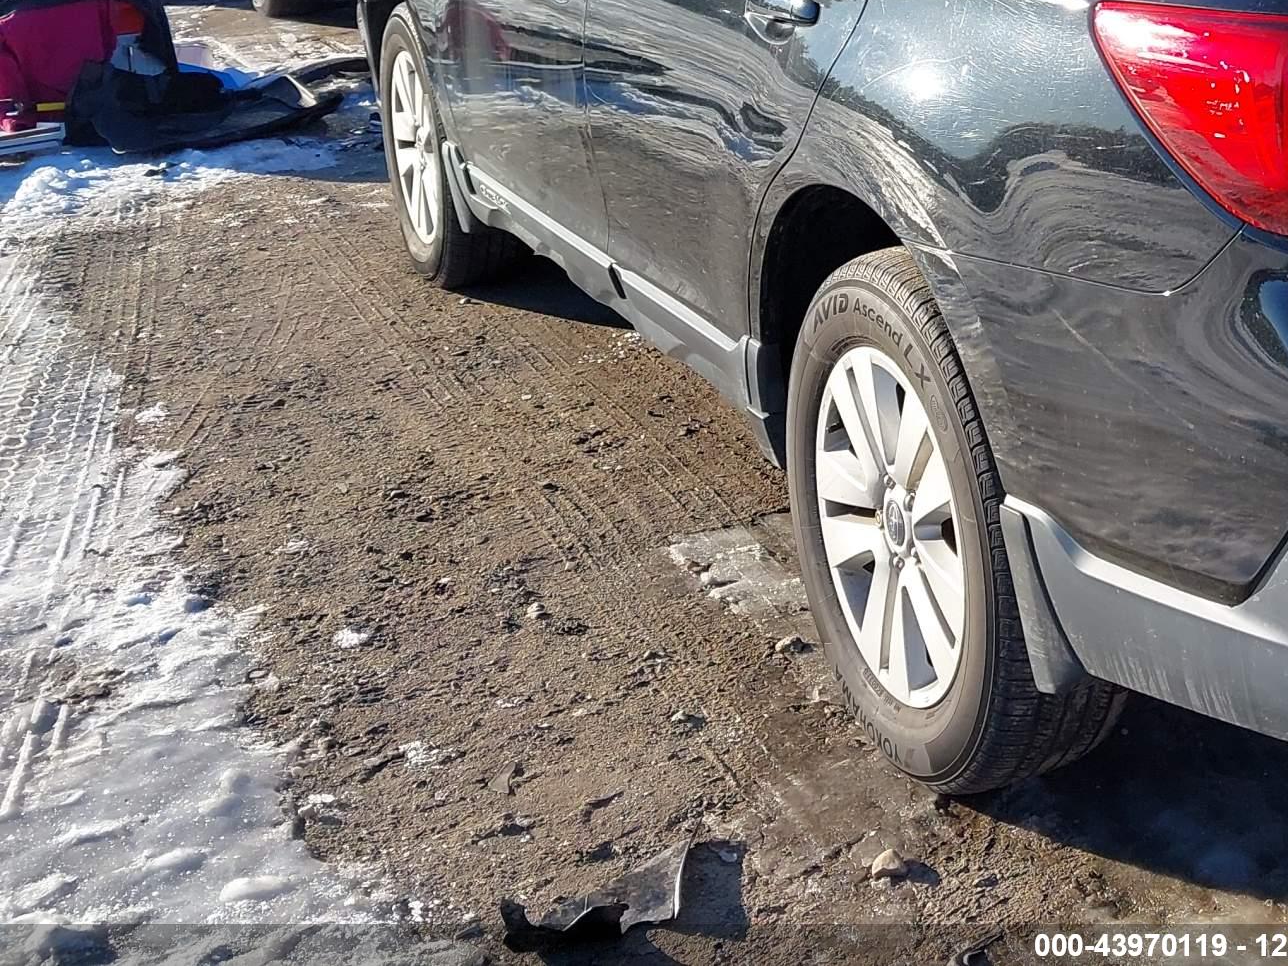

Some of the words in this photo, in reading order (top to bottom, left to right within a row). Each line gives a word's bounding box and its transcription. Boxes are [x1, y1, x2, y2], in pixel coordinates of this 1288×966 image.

[813, 293, 849, 334] AVID
[853, 297, 903, 347] Ascend
[903, 343, 931, 390] LX
